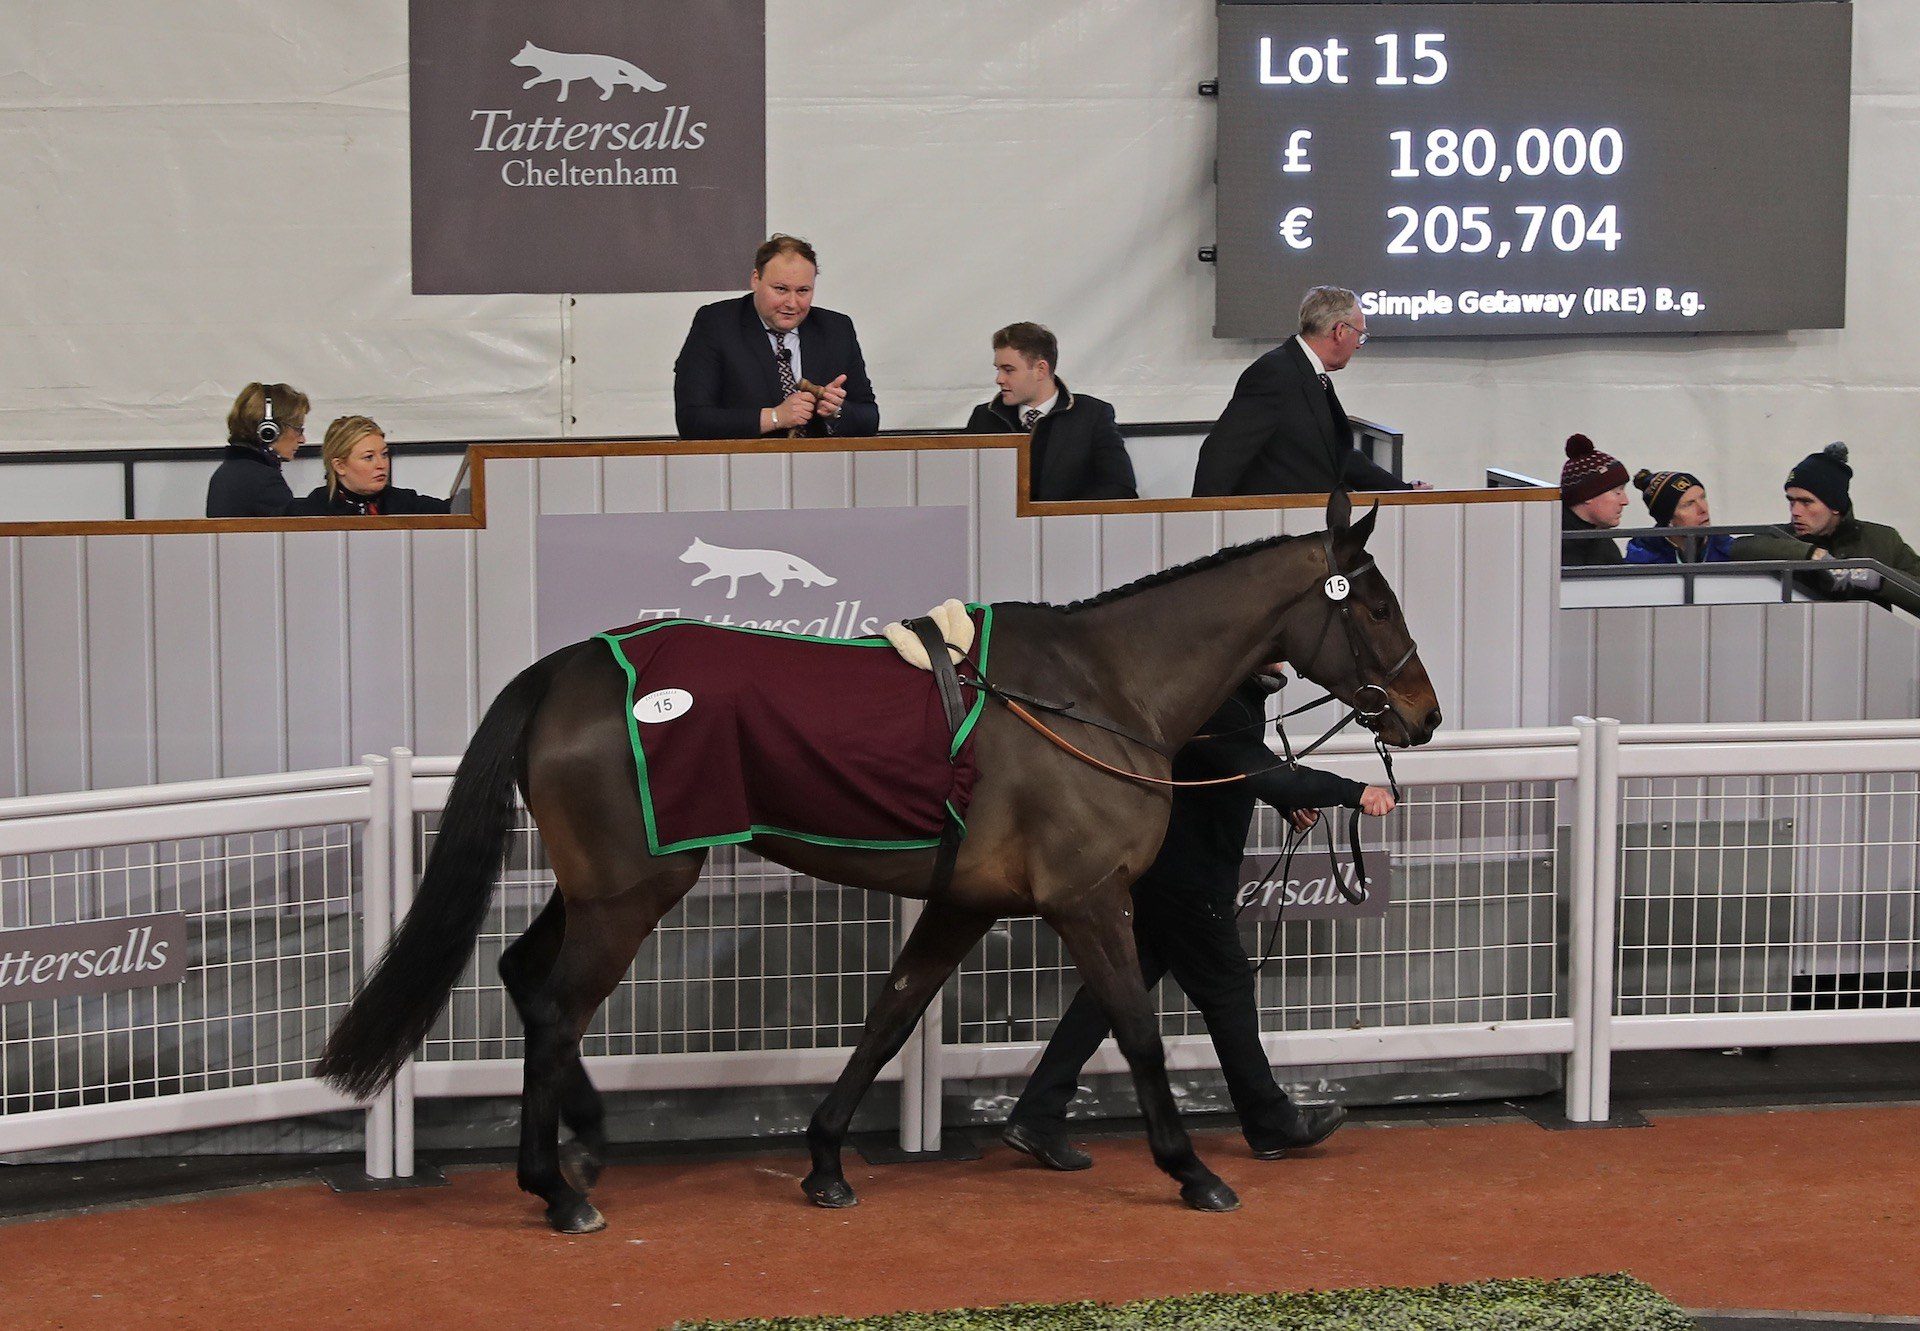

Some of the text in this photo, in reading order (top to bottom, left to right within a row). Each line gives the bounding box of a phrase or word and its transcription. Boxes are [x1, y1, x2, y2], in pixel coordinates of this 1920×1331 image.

[1259, 33, 1448, 85] Lot 15
[470, 105, 708, 152] Tattersalls
[501, 157, 679, 187] Cheltenham
[1282, 127, 1624, 182] £ 180,000
[1279, 204, 1622, 259] € 205,704
[1360, 286, 1706, 321] Simple Getaway (IRE) B.g.
[1325, 579, 1346, 594] 15
[653, 698, 673, 713] 15
